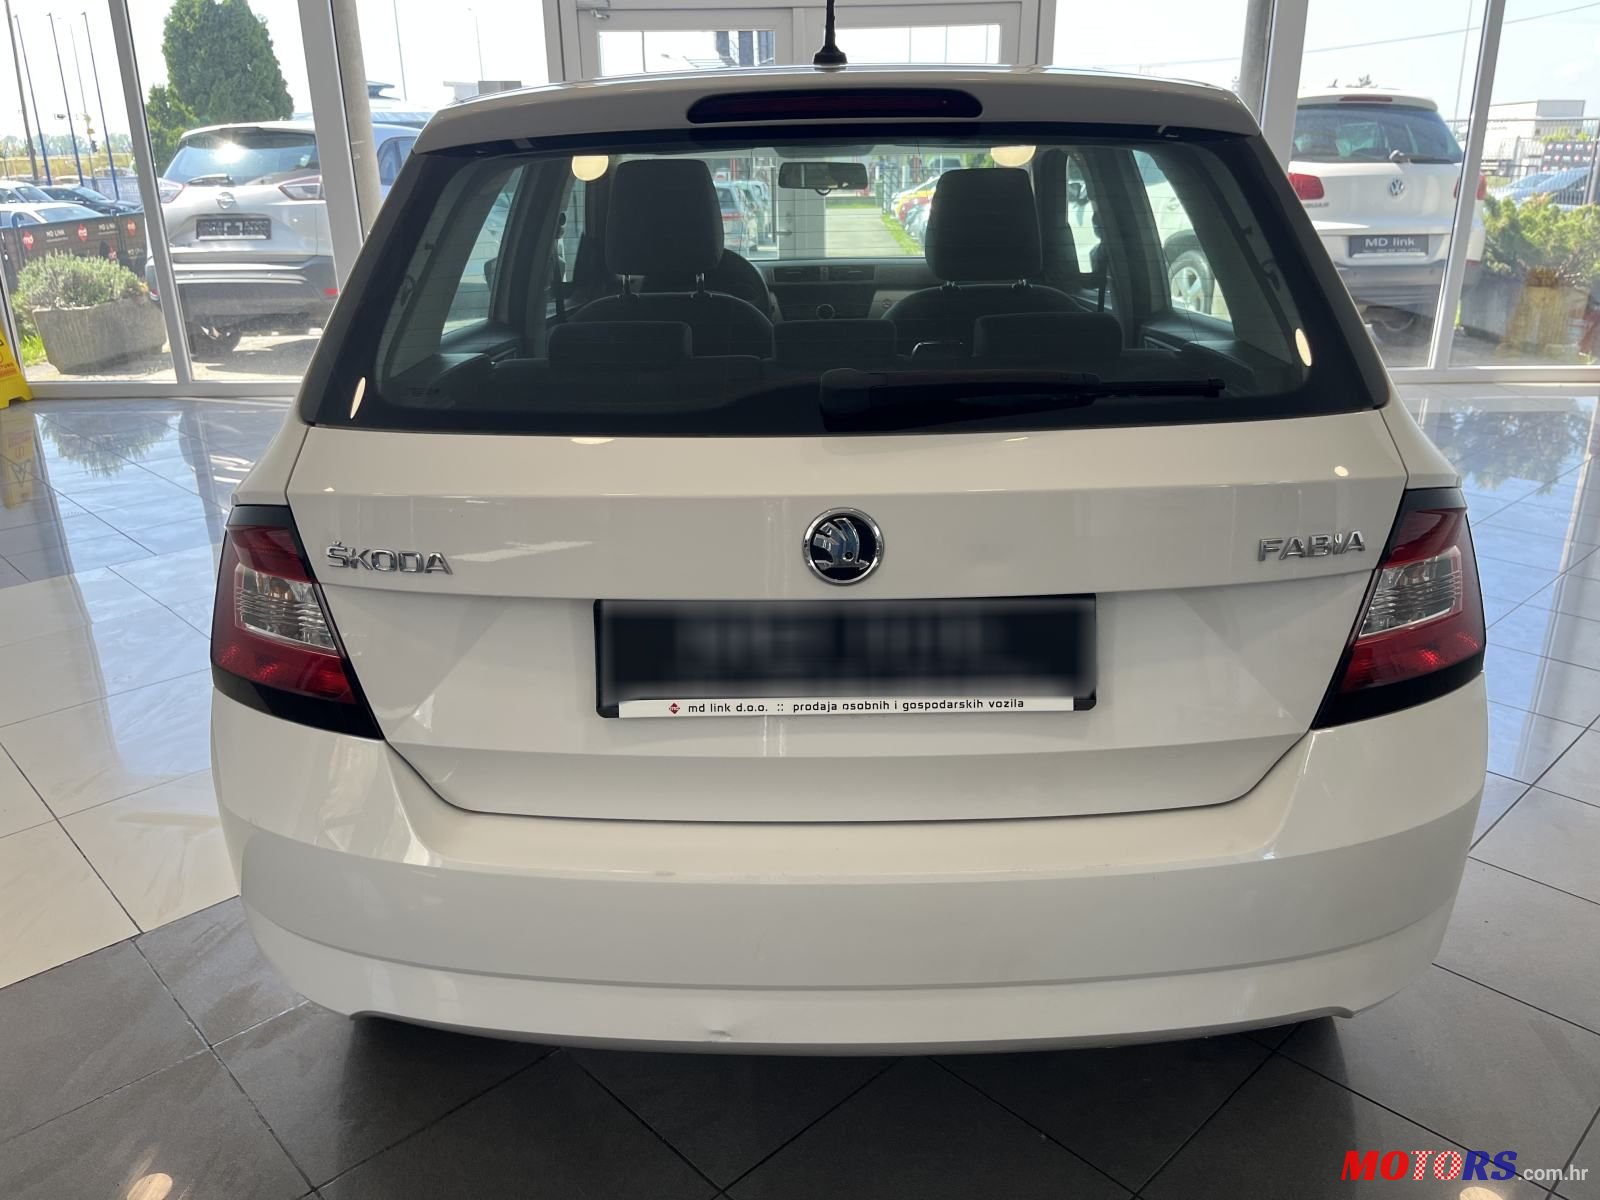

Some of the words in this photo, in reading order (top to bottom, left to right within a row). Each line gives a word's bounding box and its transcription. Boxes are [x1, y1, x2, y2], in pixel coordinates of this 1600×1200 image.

[1365, 238, 1388, 248] MD
[1392, 237, 1415, 247] link
[1258, 530, 1366, 561] FABIA
[326, 541, 453, 575] ŠKODA
[688, 703, 705, 712] md
[710, 702, 731, 713] link
[736, 702, 768, 712] d.o.o.
[793, 701, 838, 714] prodaja
[843, 700, 890, 712] osobnih
[903, 698, 984, 712] gospodarskih
[989, 698, 1024, 709] vozila
